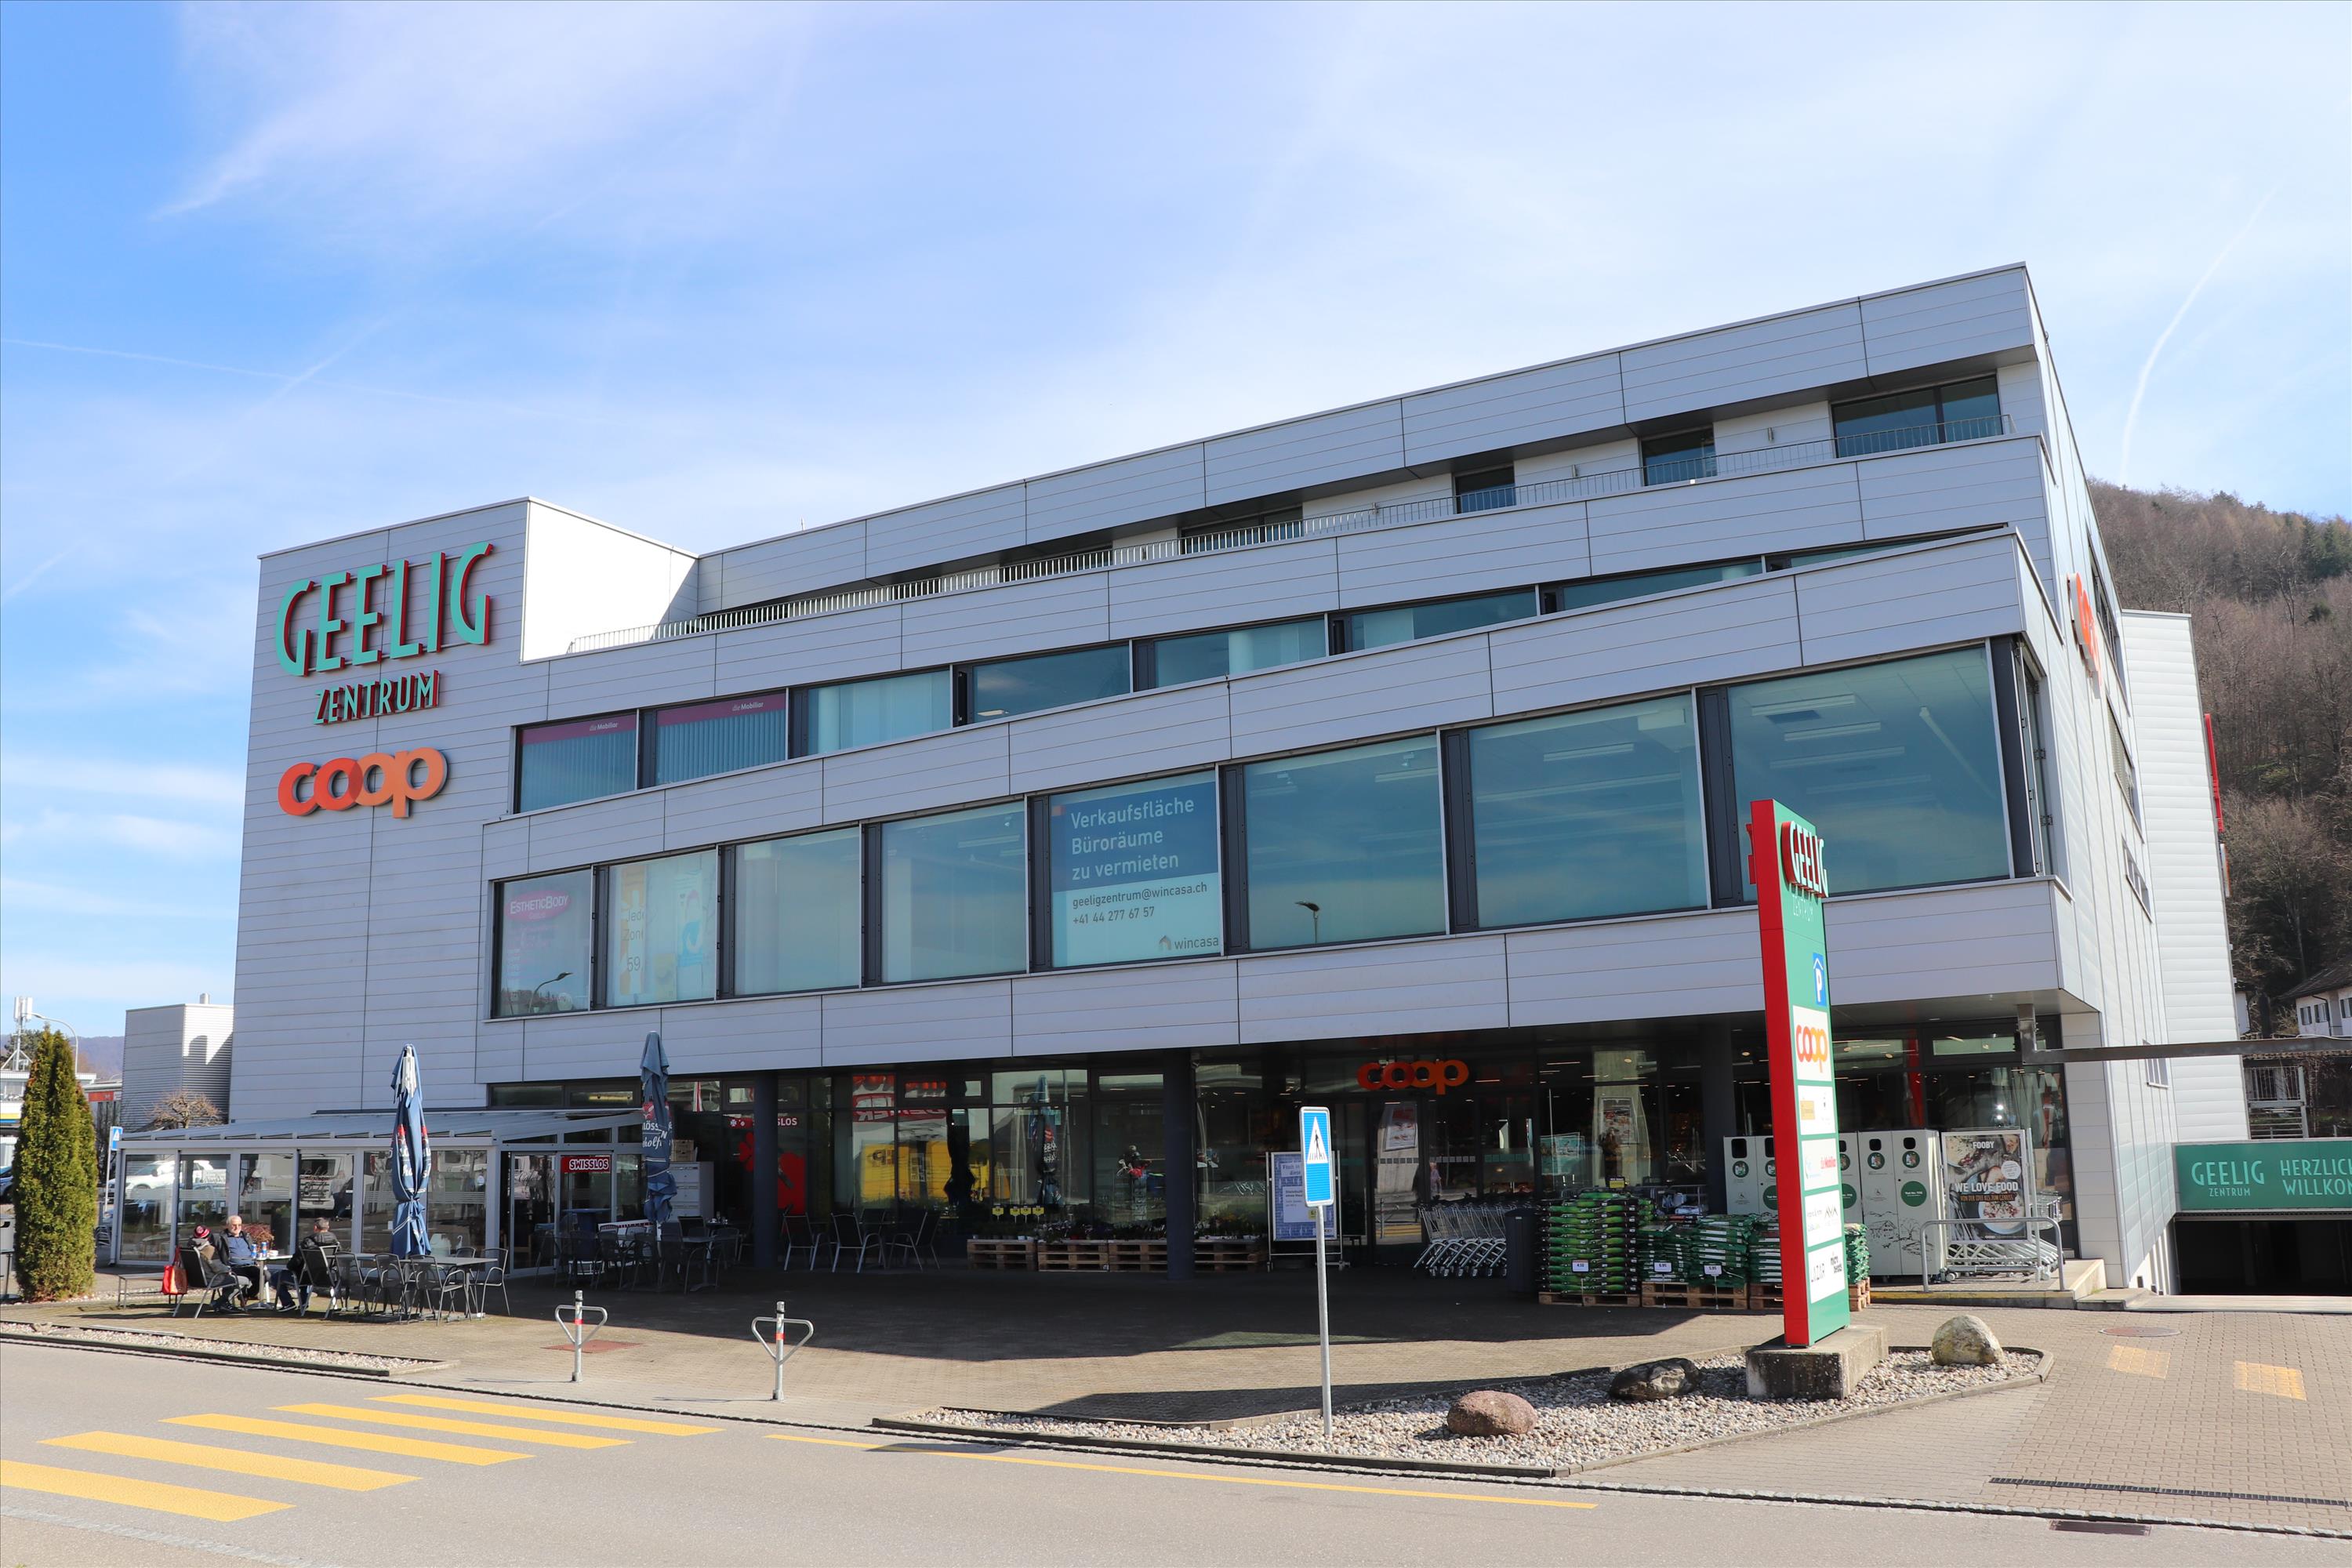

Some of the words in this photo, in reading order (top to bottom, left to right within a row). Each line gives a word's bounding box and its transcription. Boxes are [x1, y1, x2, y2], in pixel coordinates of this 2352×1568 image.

[275, 541, 494, 677] GEELIG
[314, 670, 439, 725] ZENTRUM
[740, 701, 764, 710] Mobiliar
[278, 746, 448, 818] coop
[1071, 797, 1195, 829] Verkaufsfläche
[1072, 830, 1163, 855] Büroräume
[1072, 866, 1090, 880] zu
[1095, 854, 1178, 877] vermieten
[1787, 821, 1828, 898] GEELIG
[1073, 881, 1207, 909] geeligzentrum@wincasa.ch
[1073, 913, 1088, 924] +41
[1093, 912, 1105, 922] 44
[1108, 909, 1125, 921] 277
[1128, 908, 1140, 919] 67
[1143, 906, 1155, 917] 57
[1174, 936, 1219, 949] wincasa
[1815, 967, 1823, 1003] P
[1796, 1024, 1828, 1073] coop
[1357, 1059, 1469, 1095] coop
[568, 1158, 610, 1171] SWISSLOS
[2191, 1160, 2265, 1186] GEELIG
[1955, 1182, 1969, 1192] WE
[1971, 1181, 1993, 1192] LOVE
[1996, 1181, 2019, 1192] FOOD
[2209, 1188, 2250, 1197] ZENTRUM
